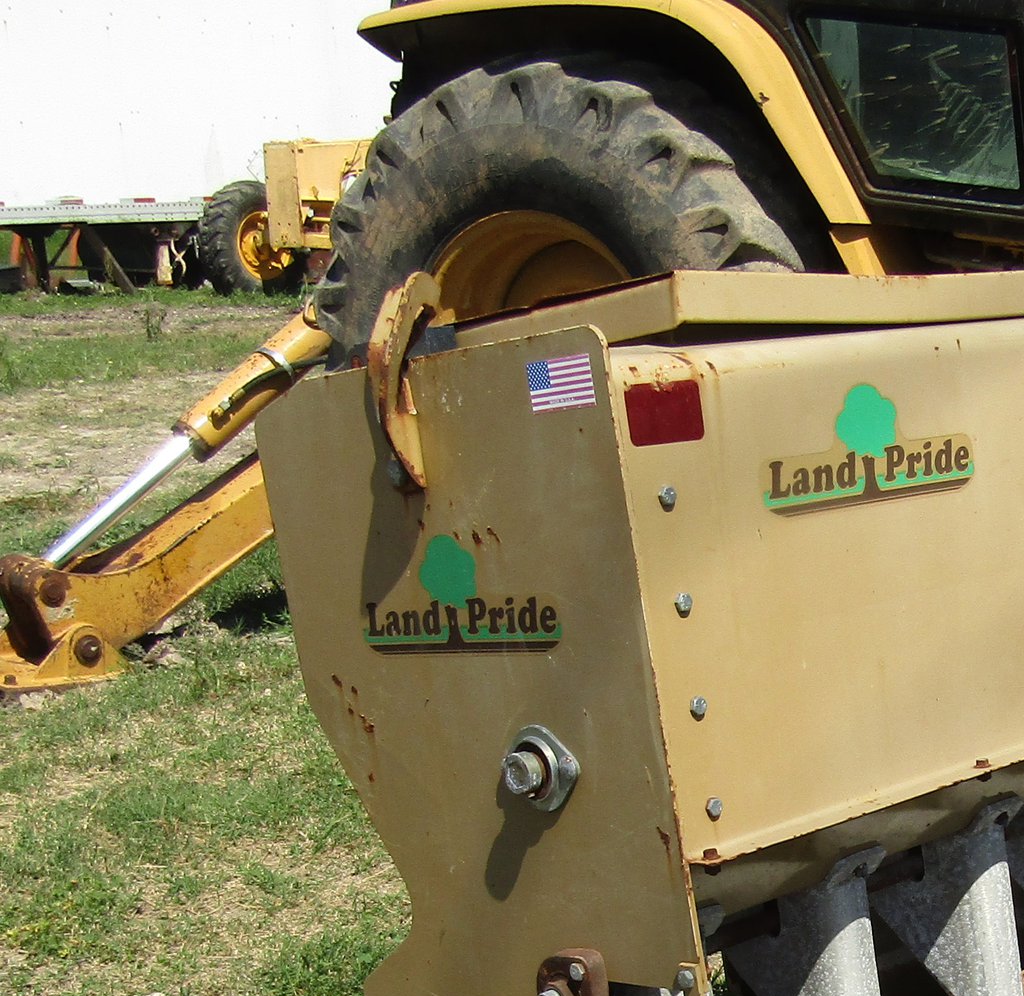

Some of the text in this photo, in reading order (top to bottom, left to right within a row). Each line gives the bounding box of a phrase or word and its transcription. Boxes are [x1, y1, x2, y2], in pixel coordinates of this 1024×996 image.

[769, 438, 971, 500] Land Pride
[366, 596, 557, 637] Land Pride
